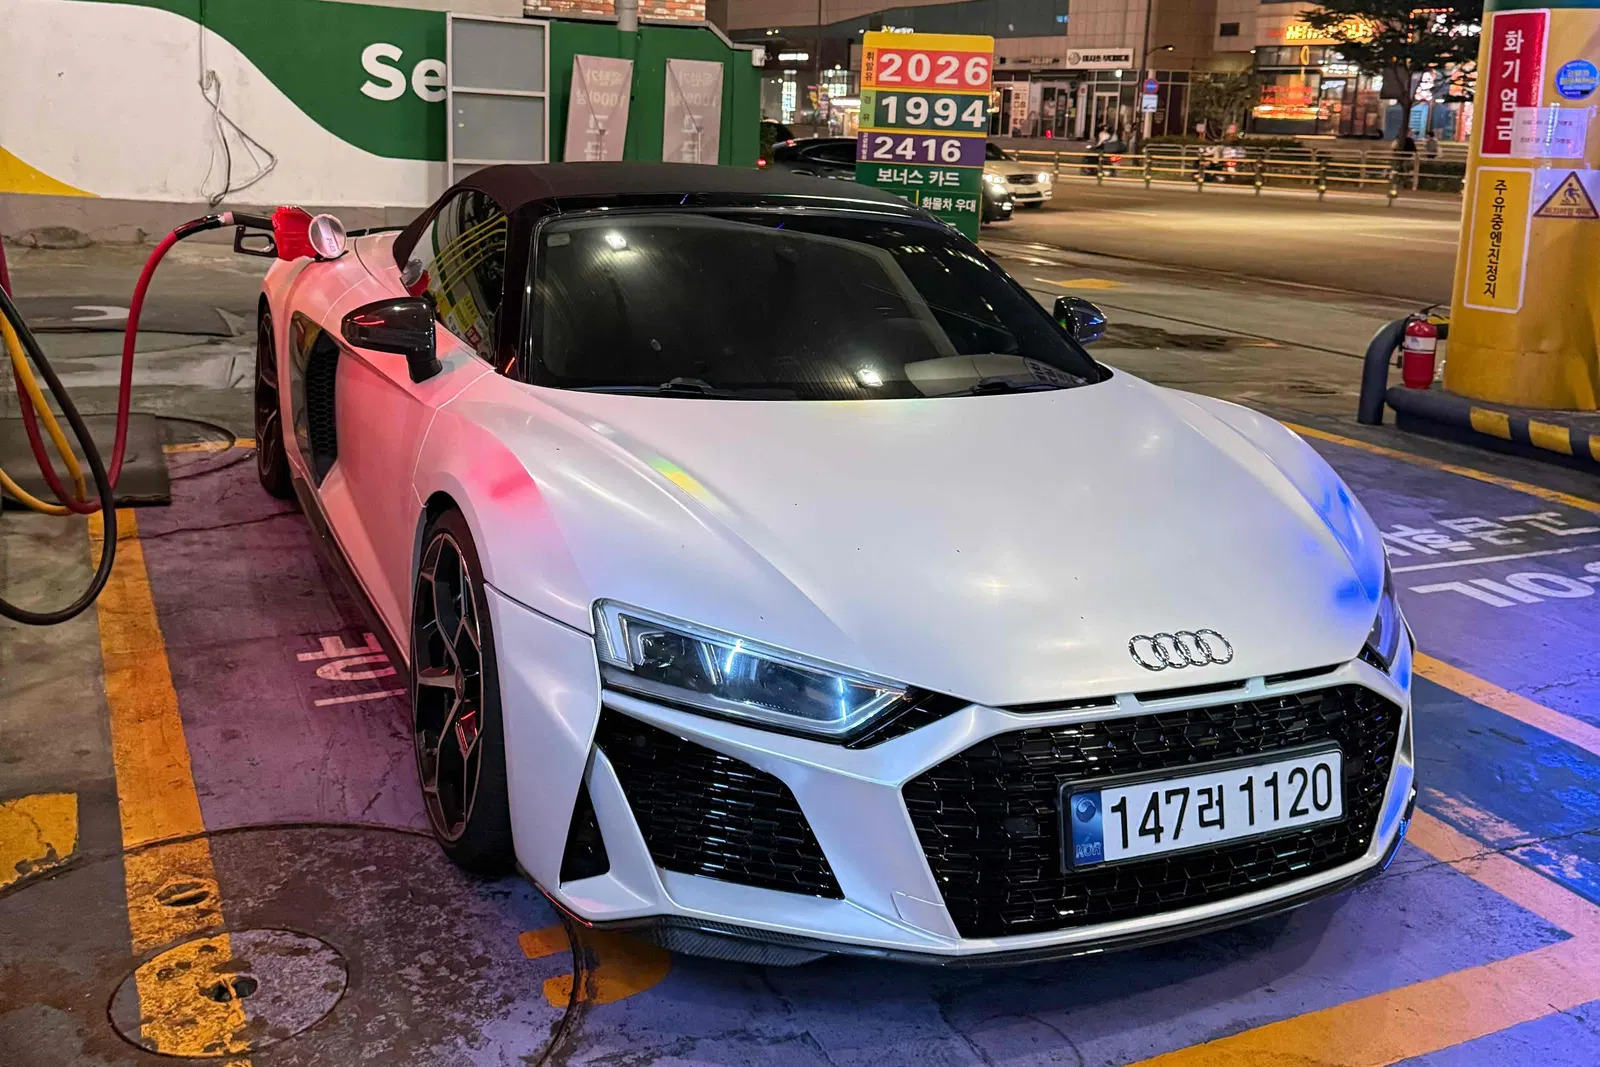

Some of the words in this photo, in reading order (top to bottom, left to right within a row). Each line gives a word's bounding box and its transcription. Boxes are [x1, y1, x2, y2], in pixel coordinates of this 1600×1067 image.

[878, 53, 989, 86] 2026
[1496, 29, 1524, 140] 화기엄금
[881, 95, 986, 128] 1994
[873, 136, 961, 162] 2416
[876, 168, 923, 185] 보너스
[929, 170, 960, 187] 카드
[922, 196, 953, 212] 화물차
[955, 199, 977, 213] 우대
[1483, 179, 1508, 298] 주유중엔진정지
[1111, 784, 1224, 849] 147러
[1239, 762, 1332, 826] 1120
[1075, 841, 1101, 859] KOR
